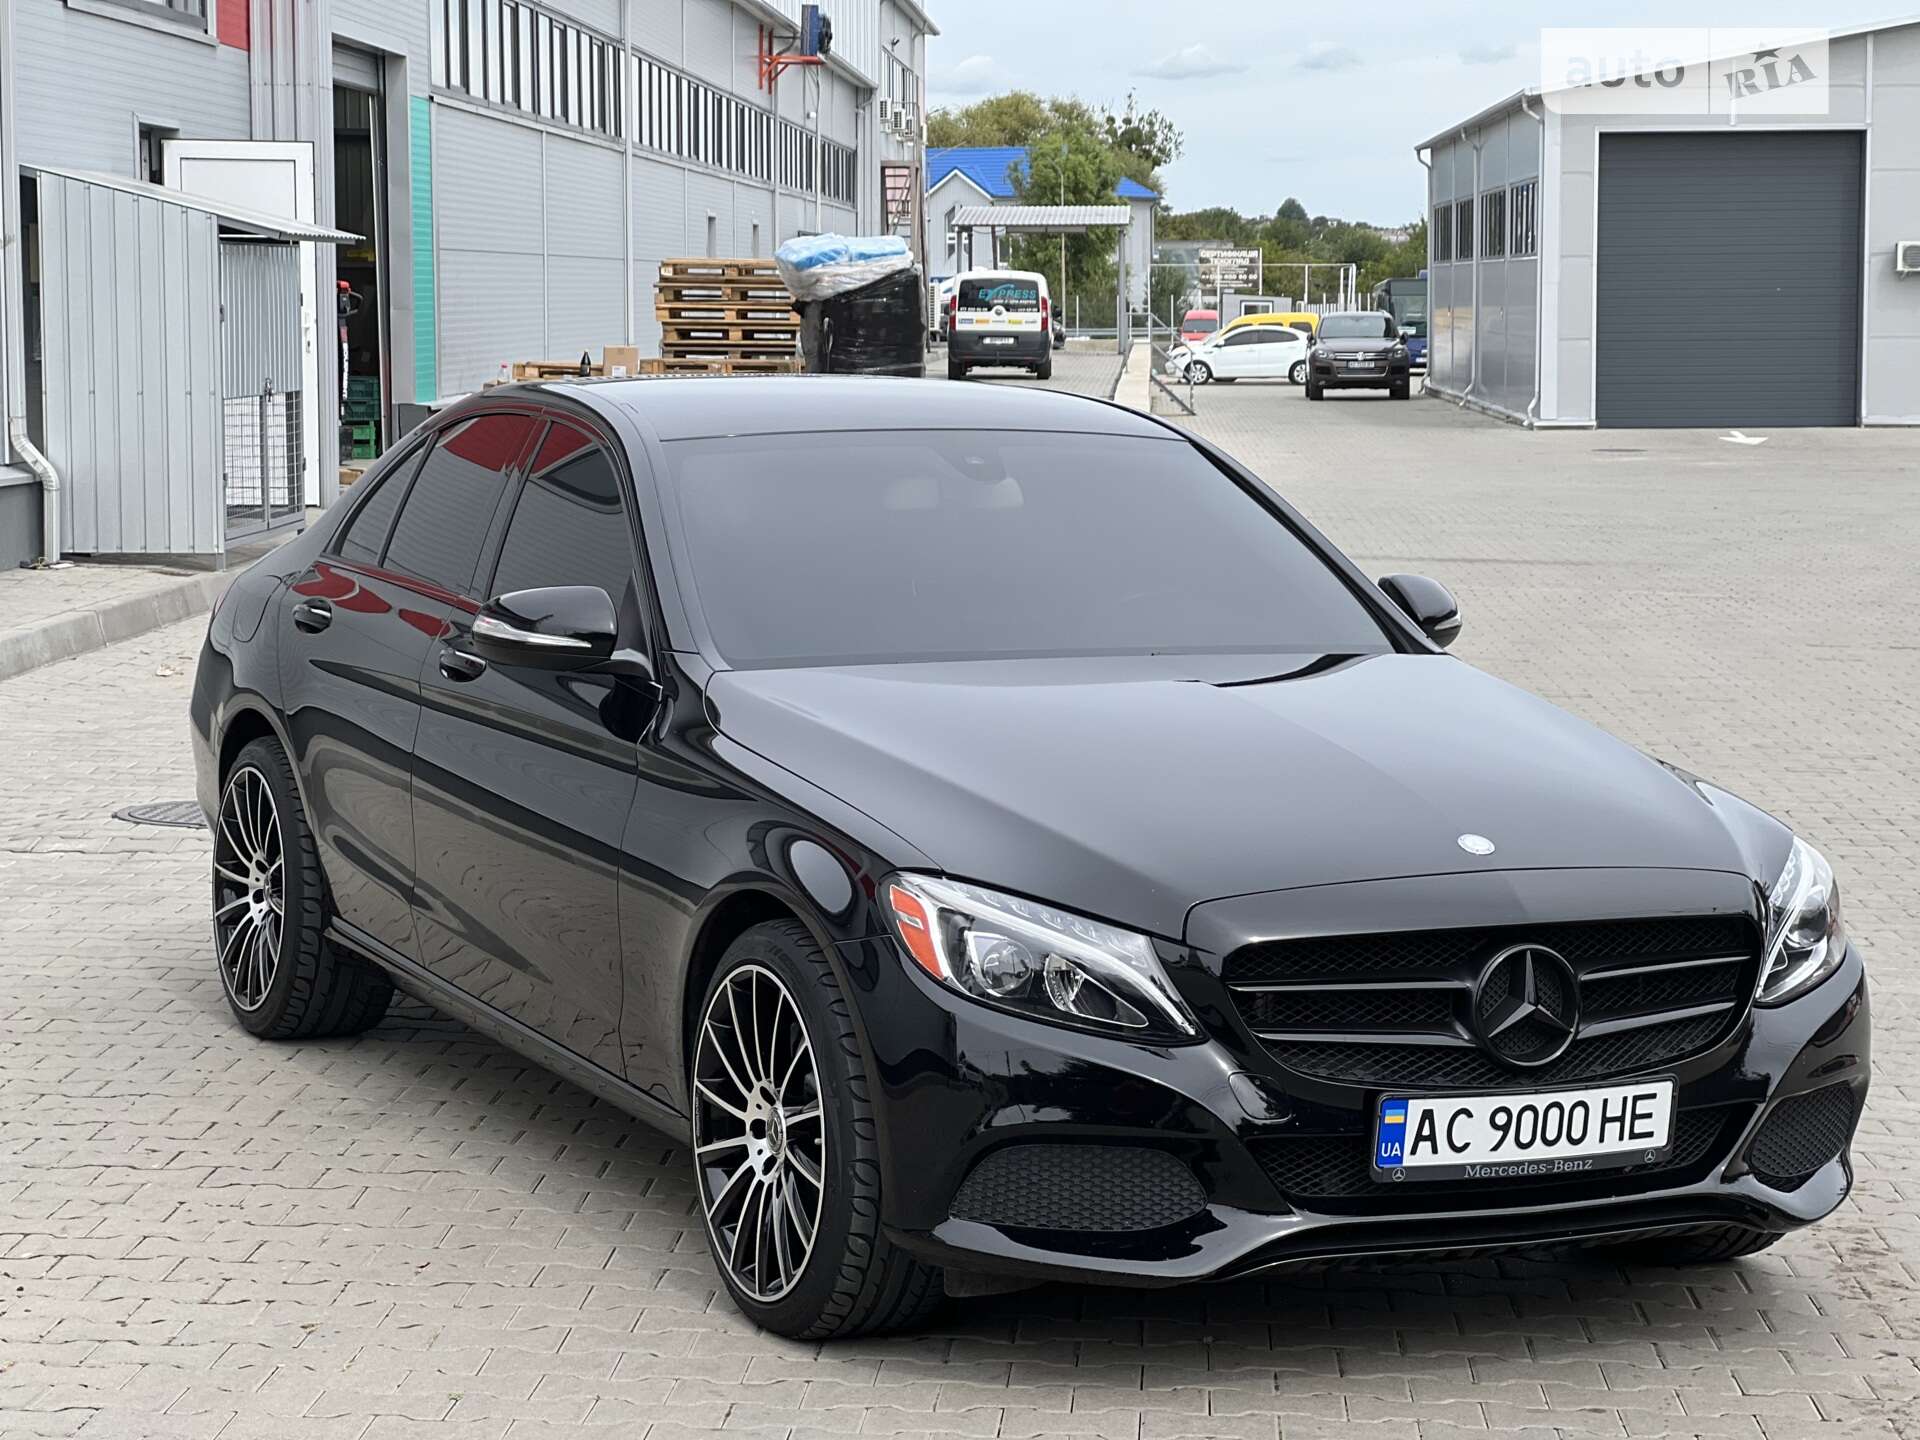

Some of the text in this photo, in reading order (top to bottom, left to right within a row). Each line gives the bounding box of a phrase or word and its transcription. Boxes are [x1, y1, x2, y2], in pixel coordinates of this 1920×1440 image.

[978, 285, 1037, 300] EXPRESS
[1409, 1092, 1658, 1156] AC 9000 HE
[1381, 1142, 1401, 1158] UA
[1463, 1158, 1593, 1179] Mercedes-Benz
